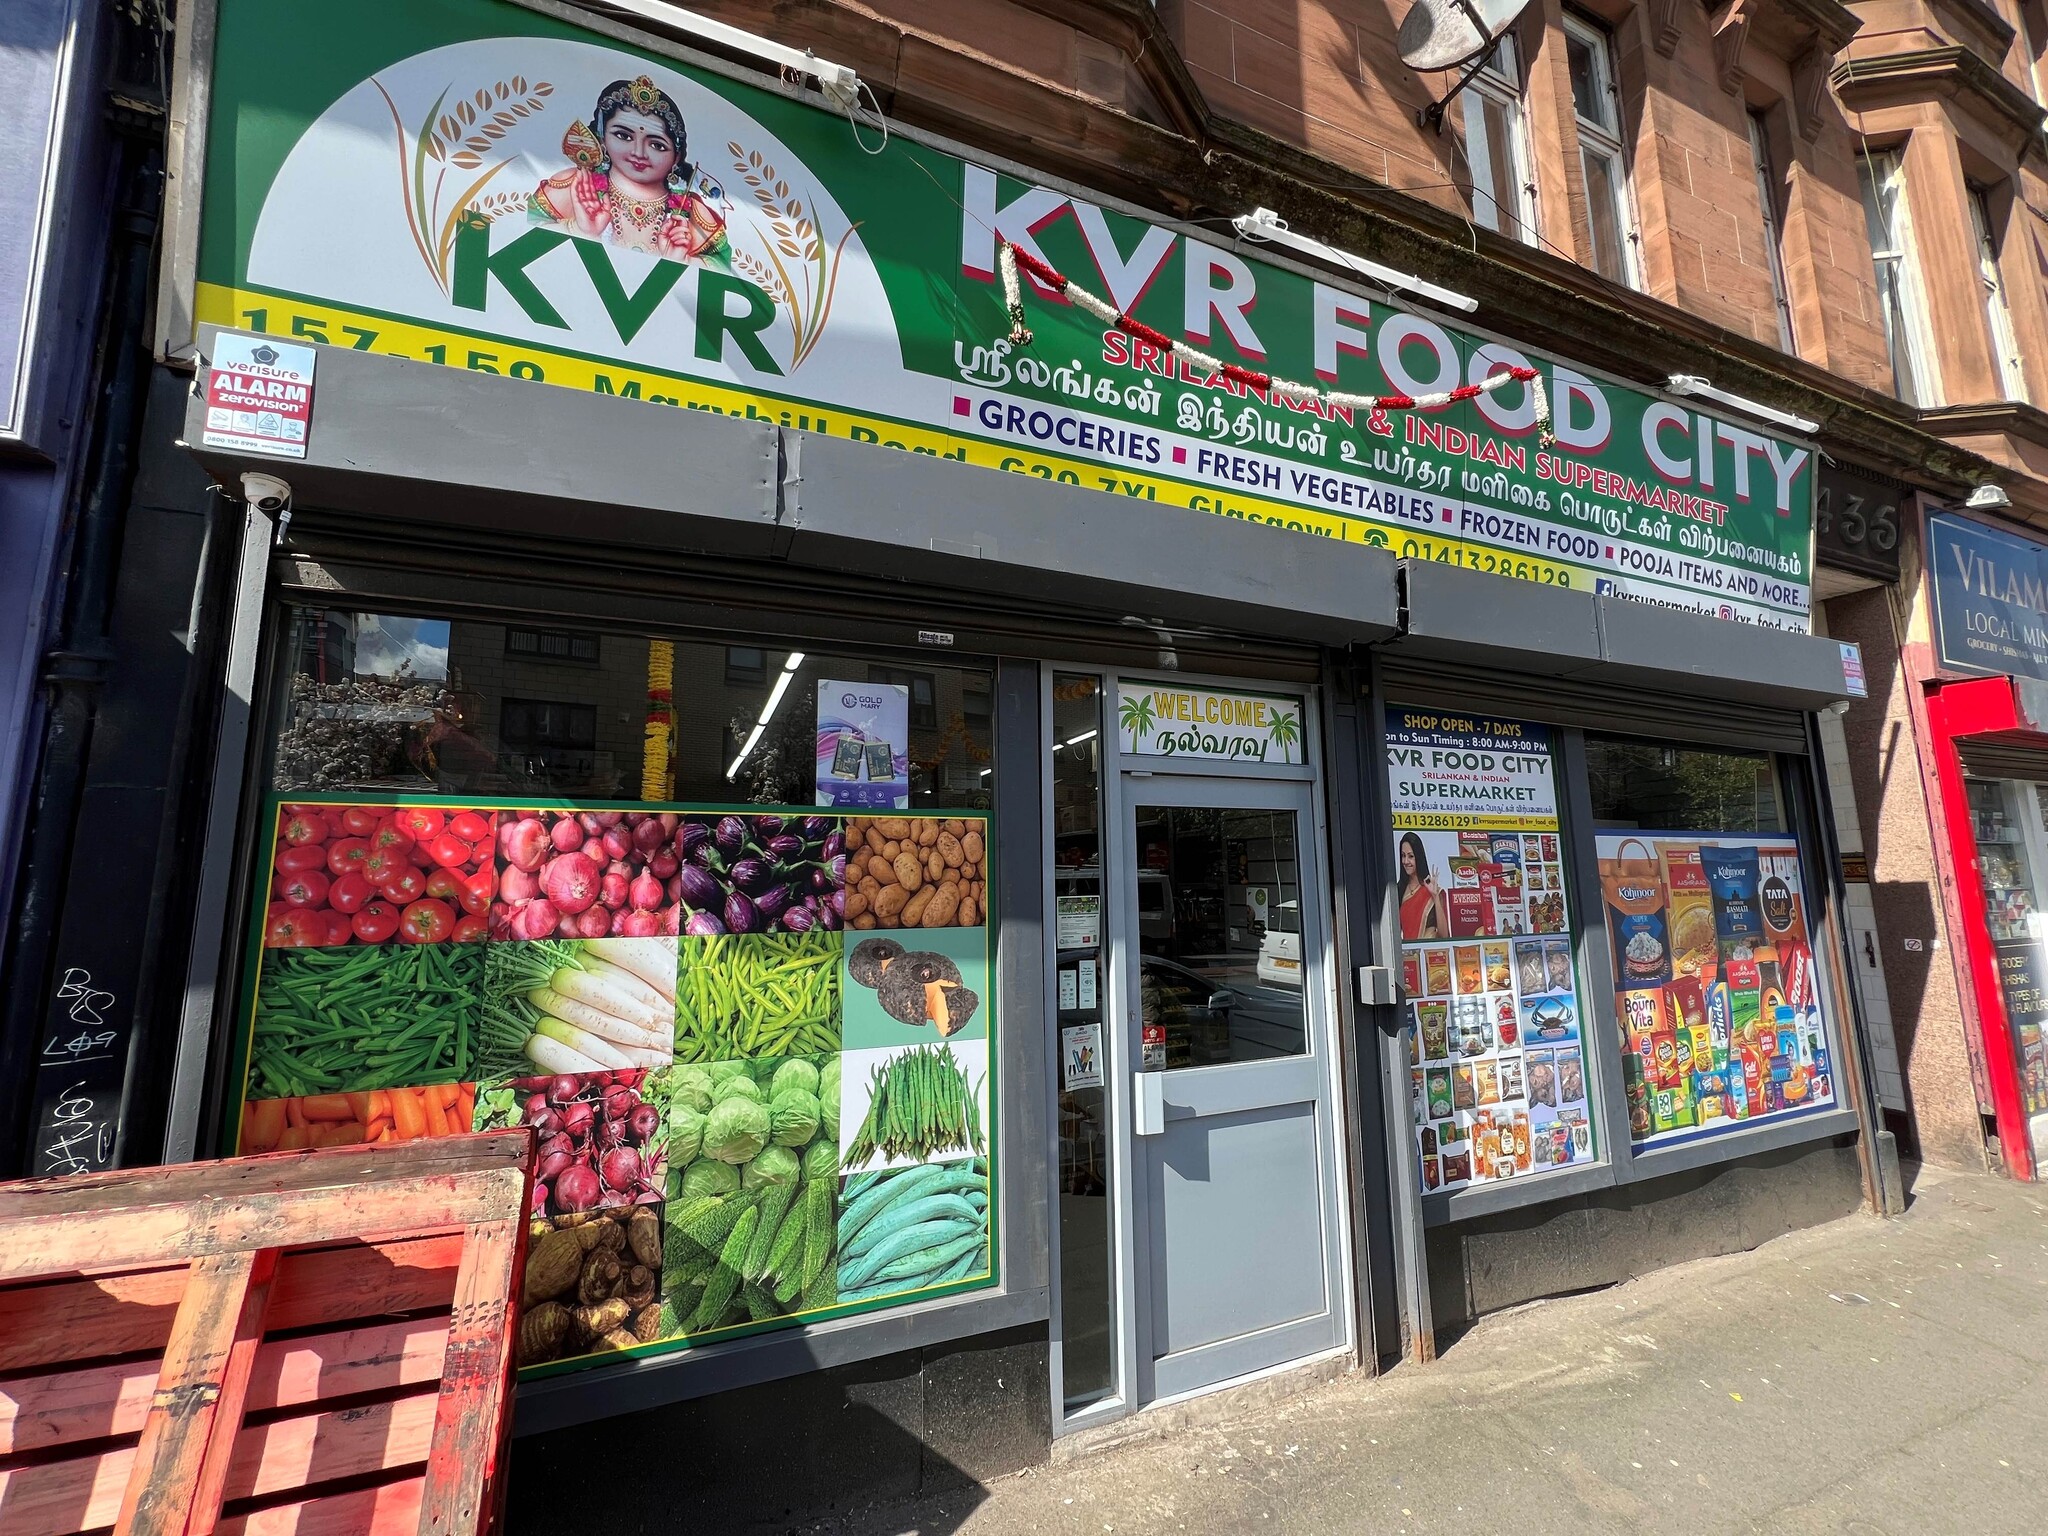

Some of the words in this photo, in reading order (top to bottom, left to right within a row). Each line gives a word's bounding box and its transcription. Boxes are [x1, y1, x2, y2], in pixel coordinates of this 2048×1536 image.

[452, 208, 785, 377] KVR
[962, 163, 1267, 361] KVR
[1313, 281, 1612, 456] FOOD
[1641, 402, 1809, 517] CITY
[227, 360, 300, 380] verisure
[213, 373, 307, 403] ALARM
[1177, 392, 1327, 456] இந்தியன்
[1340, 440, 1452, 492] உயர்தர
[1462, 471, 1551, 512] மளிகை
[1560, 491, 1672, 541] பொருட்கள்
[1366, 405, 1394, 438] &
[1405, 414, 1526, 474] INDIAN
[1535, 452, 1729, 526] SUPERMARKET
[978, 399, 1161, 464] GROCERIES
[1197, 448, 1281, 490] FRESH
[1290, 469, 1434, 524] VEGETABLES
[1460, 509, 1541, 548] FROZEN
[1547, 529, 1599, 560] FOOD
[1620, 546, 1674, 577] POOJA
[1678, 561, 1723, 589] ITEMS
[1726, 574, 1758, 596] AND
[1950, 542, 2048, 614] VILAM
[1965, 609, 2020, 642] LOCAL
[859, 695, 883, 704] GOLD
[1153, 691, 1268, 728] WELCOME
[1404, 714, 1438, 730] SHOP
[1441, 717, 1474, 733] OPEN
[1483, 721, 1491, 734] 7
[1494, 723, 1522, 737] DAYS
[1156, 724, 1268, 762] நல்வரவு
[1399, 732, 1410, 742] to
[1411, 732, 1430, 743] Sun
[1431, 734, 1464, 748] Timing
[1472, 736, 1493, 748] 8:00
[1534, 741, 1548, 752] PM
[1432, 751, 1495, 772] FOOD
[1502, 755, 1548, 775] CITY
[1421, 771, 1471, 781] SRILANKAN
[1472, 774, 1479, 782] &
[1481, 775, 1510, 783] INDIAN
[1399, 781, 1536, 801] SUPERMARKET
[1391, 814, 1470, 827] 01413286129
[1458, 867, 1475, 876] Aachi
[1618, 886, 1656, 901] Kohinoor
[1765, 888, 1788, 900] TATA
[1770, 900, 1787, 917] Salt
[1624, 997, 1656, 1014] Bourn
[1630, 1010, 1653, 1032] Vita
[1711, 995, 1726, 1041] orlicks
